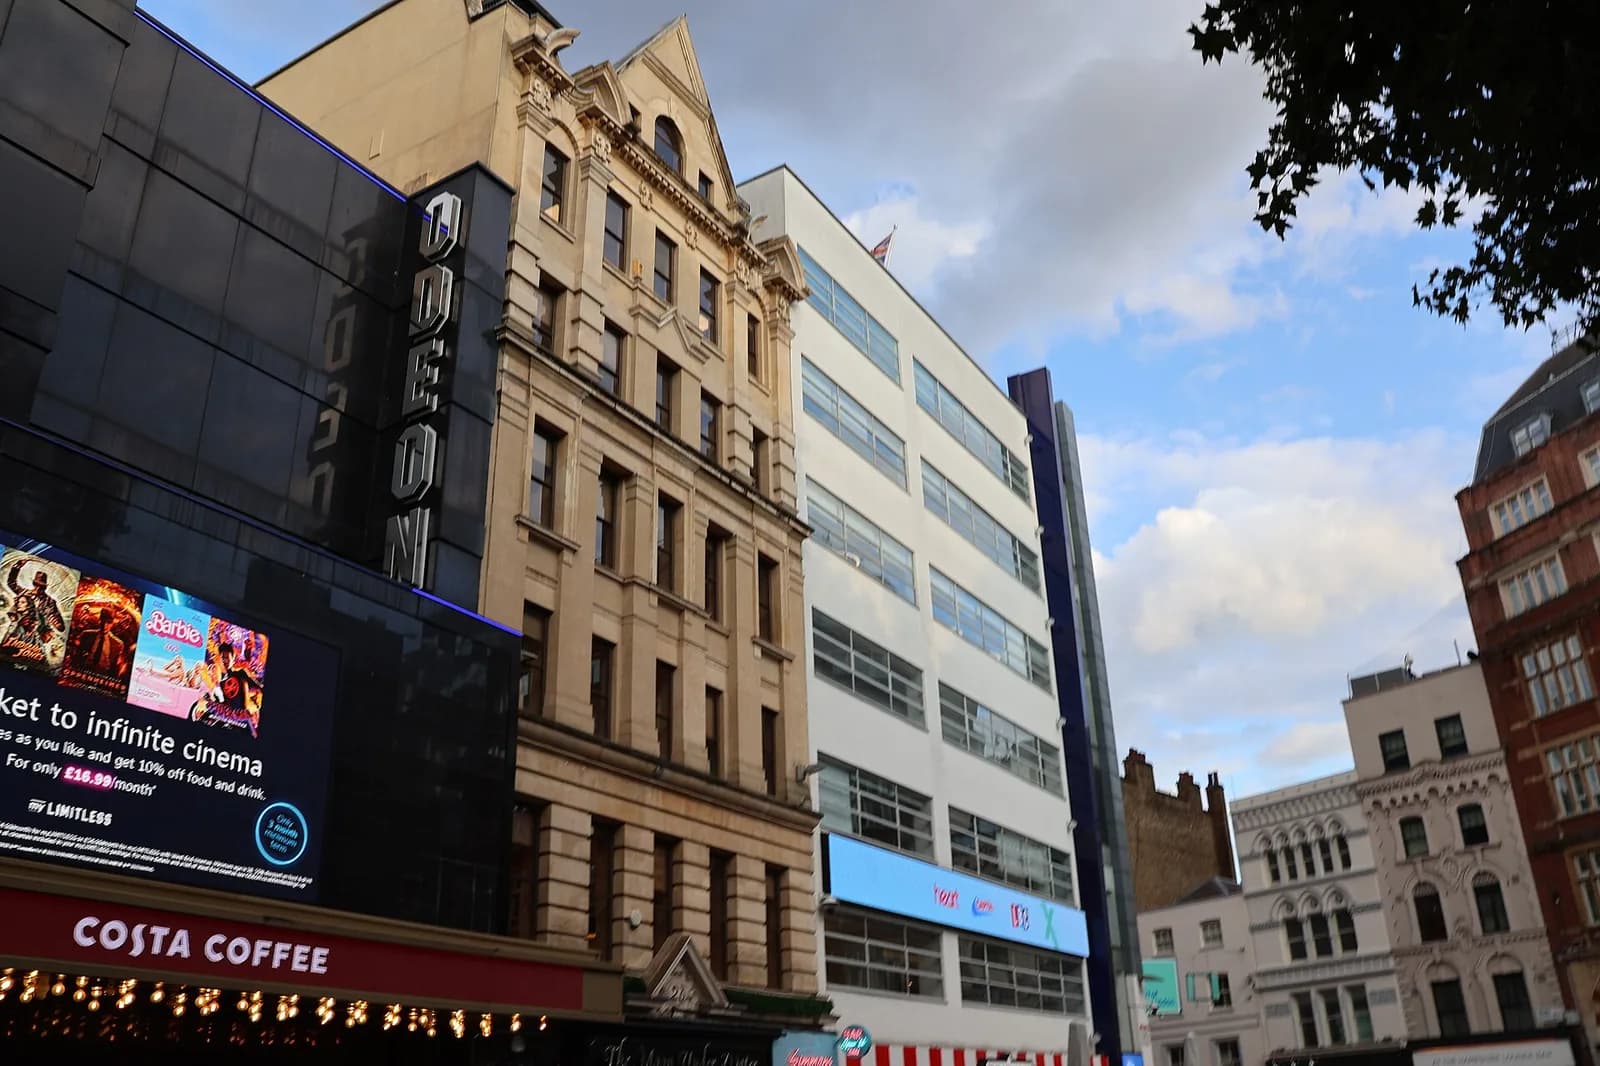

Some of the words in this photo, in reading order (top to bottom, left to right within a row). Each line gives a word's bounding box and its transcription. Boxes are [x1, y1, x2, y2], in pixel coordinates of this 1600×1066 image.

[384, 191, 462, 590] ODEON
[145, 610, 204, 646] Barbie
[6, 753, 31, 770] For
[32, 762, 62, 780] only
[15, 733, 33, 746] as
[35, 736, 60, 751] you
[62, 740, 86, 758] like
[87, 750, 112, 764] and
[113, 756, 136, 770] get
[137, 759, 166, 777] 10%
[167, 767, 186, 781] off
[186, 770, 213, 788] food
[214, 780, 236, 793] and
[237, 783, 267, 801] drink.
[50, 703, 78, 730] to
[86, 710, 175, 755] infinite
[183, 739, 263, 778] cinema
[46, 802, 113, 827] LIMITLESS
[73, 916, 191, 958] COSTA
[204, 933, 330, 975] COFFEE
